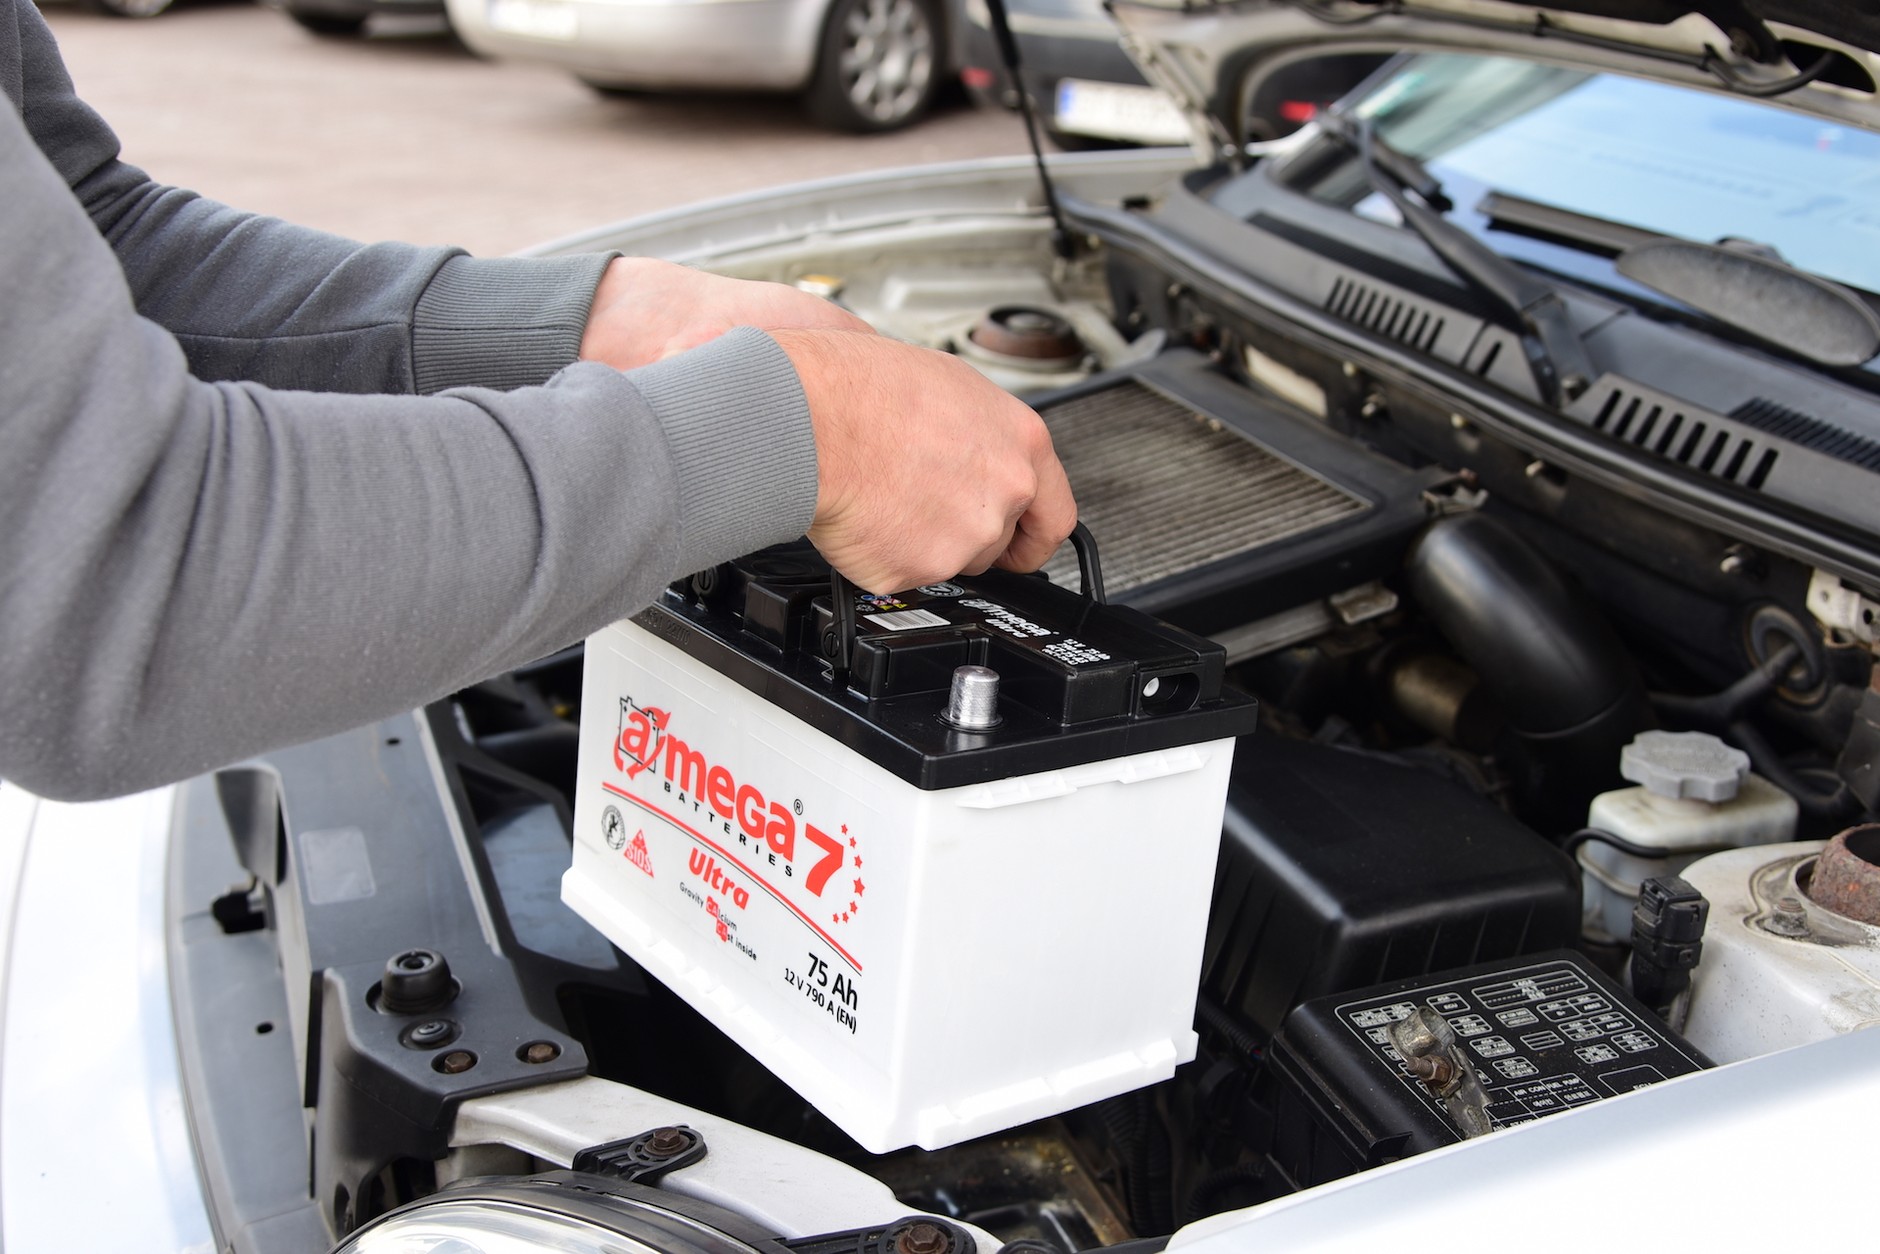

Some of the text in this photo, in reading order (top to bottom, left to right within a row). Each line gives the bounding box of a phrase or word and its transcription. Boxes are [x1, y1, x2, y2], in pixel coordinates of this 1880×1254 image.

[664, 781, 793, 877] BATTERIES
[626, 841, 652, 874] SIOS
[688, 847, 750, 910] Ultra
[805, 822, 845, 898] 7
[679, 881, 704, 908] Gravity
[735, 937, 757, 961] inside
[784, 968, 857, 1035] 12 V 790 A (EN)
[808, 952, 858, 1011] 75 Ah
[1514, 1086, 1546, 1097] AIR CON
[1547, 1078, 1580, 1089] FUEL PUMP
